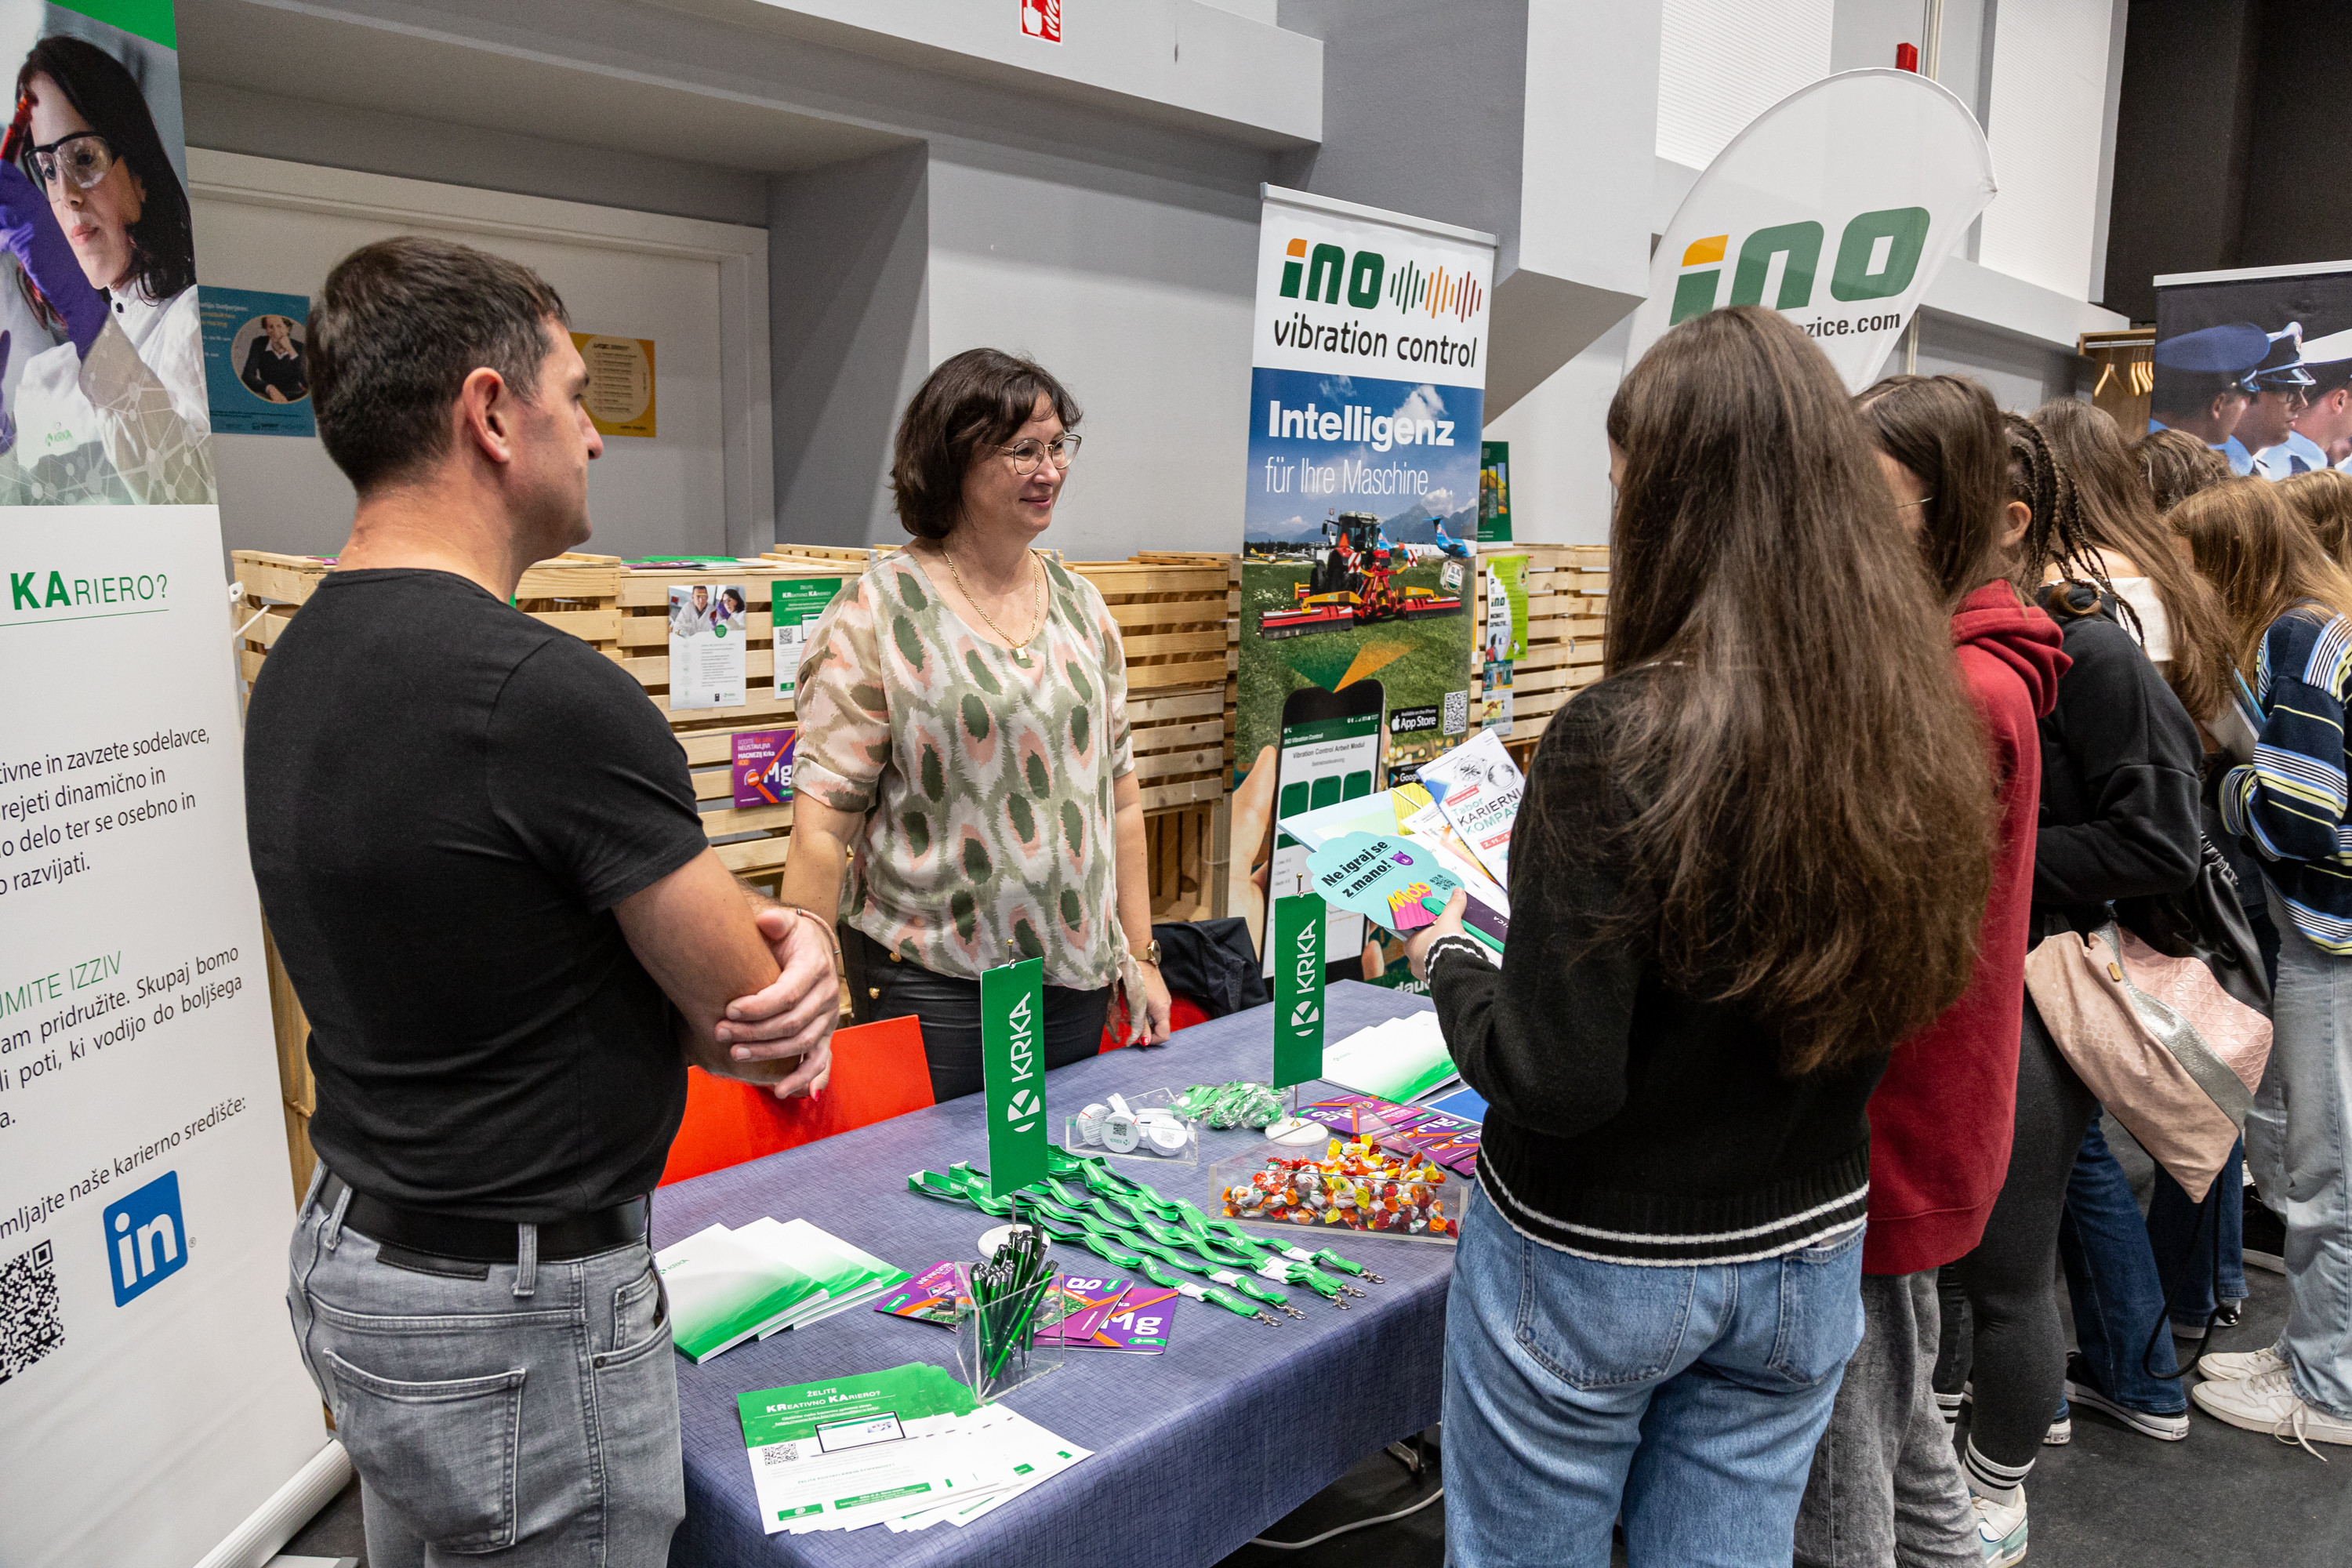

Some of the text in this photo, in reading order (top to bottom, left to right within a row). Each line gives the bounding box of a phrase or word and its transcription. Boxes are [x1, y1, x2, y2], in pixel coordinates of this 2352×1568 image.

[1279, 238, 1385, 310] ino
[1668, 206, 1930, 326] ino
[1274, 311, 1477, 368] vibration control
[1797, 313, 1900, 338] zice.com
[1269, 400, 1455, 452] Intelligenz
[1265, 456, 1428, 495] für Ihre Maschine
[10, 570, 168, 611] KARIERO?
[1400, 716, 1436, 731] App Store
[45, 753, 63, 774] in
[67, 741, 129, 770] zavzete
[133, 728, 210, 757] sodelavce,
[1293, 749, 1314, 758] Vibration
[1316, 746, 1334, 755] Control
[0, 768, 165, 822] rejeti dinamično in
[1451, 797, 1483, 816] Tabor
[1457, 788, 1523, 827] KARIERNI
[0, 792, 197, 858] o delo ter se osebno in
[13, 852, 91, 891] razvijati.
[1321, 840, 1388, 887] Ne igraj se
[1341, 859, 1392, 898] z mano!
[1386, 881, 1432, 913] Mjob
[1494, 916, 1508, 928] ICA
[70, 950, 122, 990] IZZIV
[1297, 918, 1316, 994] KRKA
[40, 989, 129, 1044] pridružite.
[136, 962, 191, 1000] Skupaj
[196, 946, 238, 976] bomo
[1394, 981, 1430, 993] dau
[19, 1049, 63, 1089] poti,
[71, 1036, 85, 1063] ki
[93, 1017, 146, 1054] vodijo
[153, 1002, 174, 1026] do
[181, 975, 242, 1017] boljšega
[1009, 991, 1033, 1083] KRKA
[70, 1168, 110, 1201] naše
[114, 1132, 180, 1178] karierno
[184, 1094, 246, 1141] središče:
[114, 1212, 179, 1290] in
[1100, 1312, 1163, 1335] Mg
[766, 1390, 880, 1414] KREATIVNO KARIERO?
[807, 1388, 837, 1397] ŽELITE
